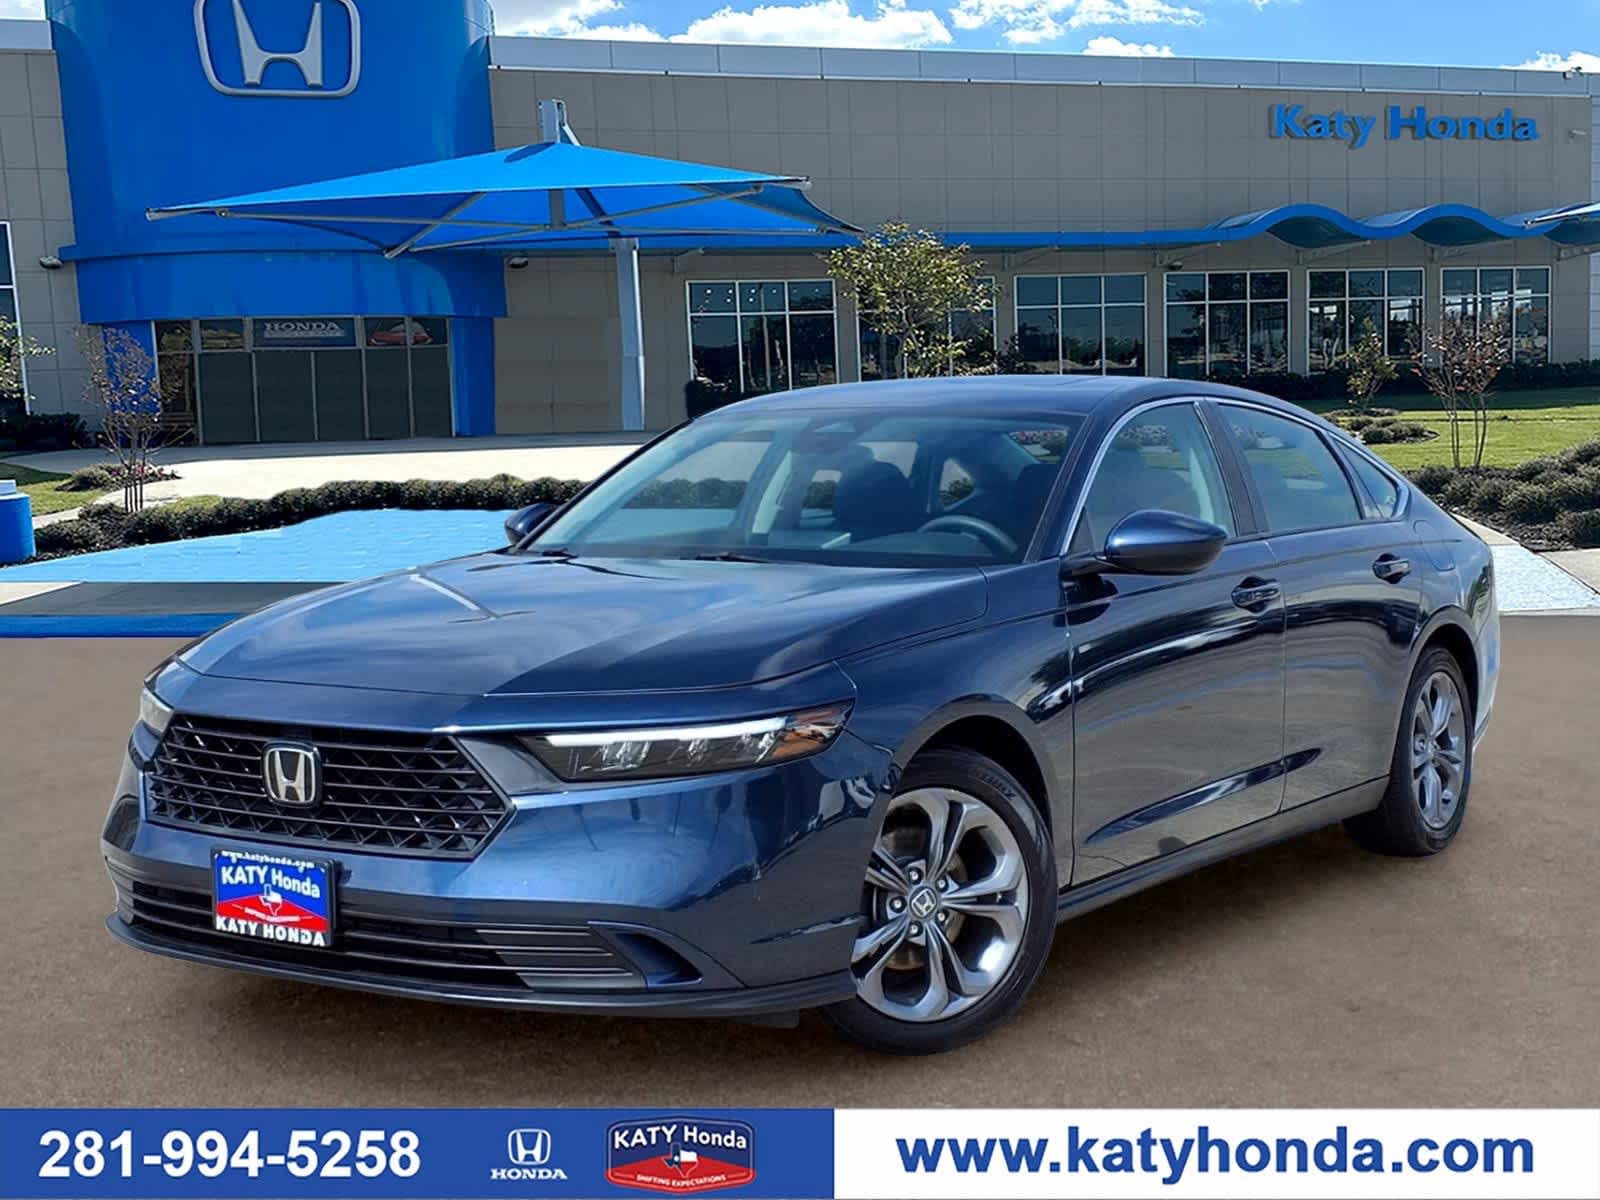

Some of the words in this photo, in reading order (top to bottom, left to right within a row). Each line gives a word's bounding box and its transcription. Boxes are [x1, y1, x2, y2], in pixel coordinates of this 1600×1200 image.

[1271, 103, 1377, 149] Katy
[1386, 104, 1539, 142] Honda
[264, 321, 342, 332] HONDA
[221, 865, 268, 885] KATY
[270, 867, 321, 899] Honda
[215, 915, 258, 936] KATY
[262, 923, 326, 947] HONDA
